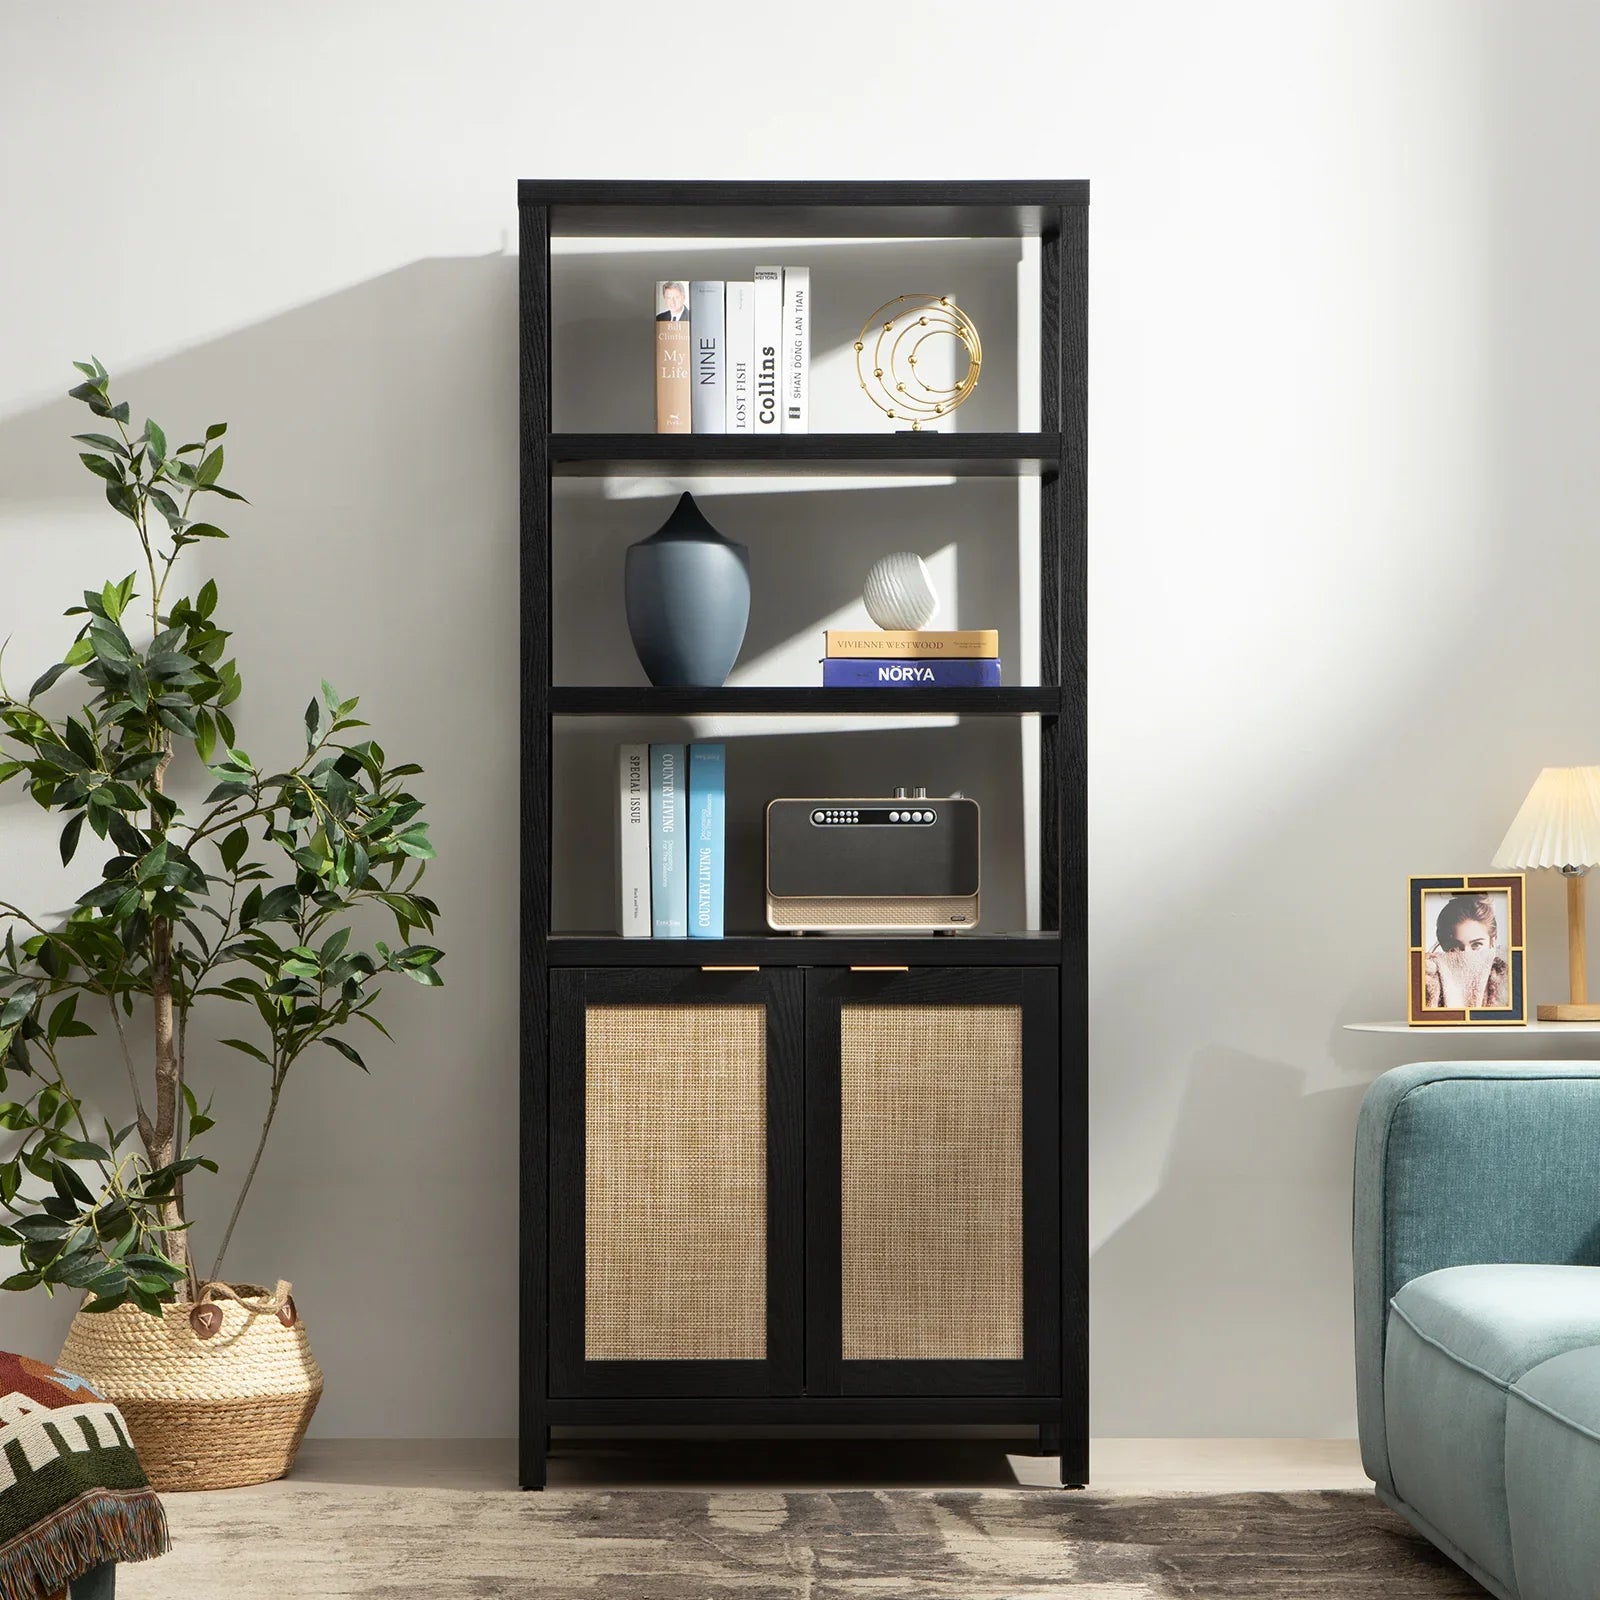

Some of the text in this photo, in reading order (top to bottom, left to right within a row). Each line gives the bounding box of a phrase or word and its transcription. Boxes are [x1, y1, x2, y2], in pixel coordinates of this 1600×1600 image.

[662, 367, 689, 379] Life
[663, 350, 686, 365] My
[700, 337, 716, 385] NINE
[793, 290, 804, 399] SHAN DONG LAN TIAN
[736, 363, 746, 428] LOST FISH
[759, 346, 775, 424] Collins
[837, 640, 885, 649] VIVIENNE
[885, 640, 944, 650] WESTWOOD
[878, 665, 935, 681] NÖRYA
[630, 755, 641, 824] SPECIAL ISSUE
[662, 753, 674, 833] COUNTRY LIVING
[698, 847, 711, 927] COUNTRY LIVING
